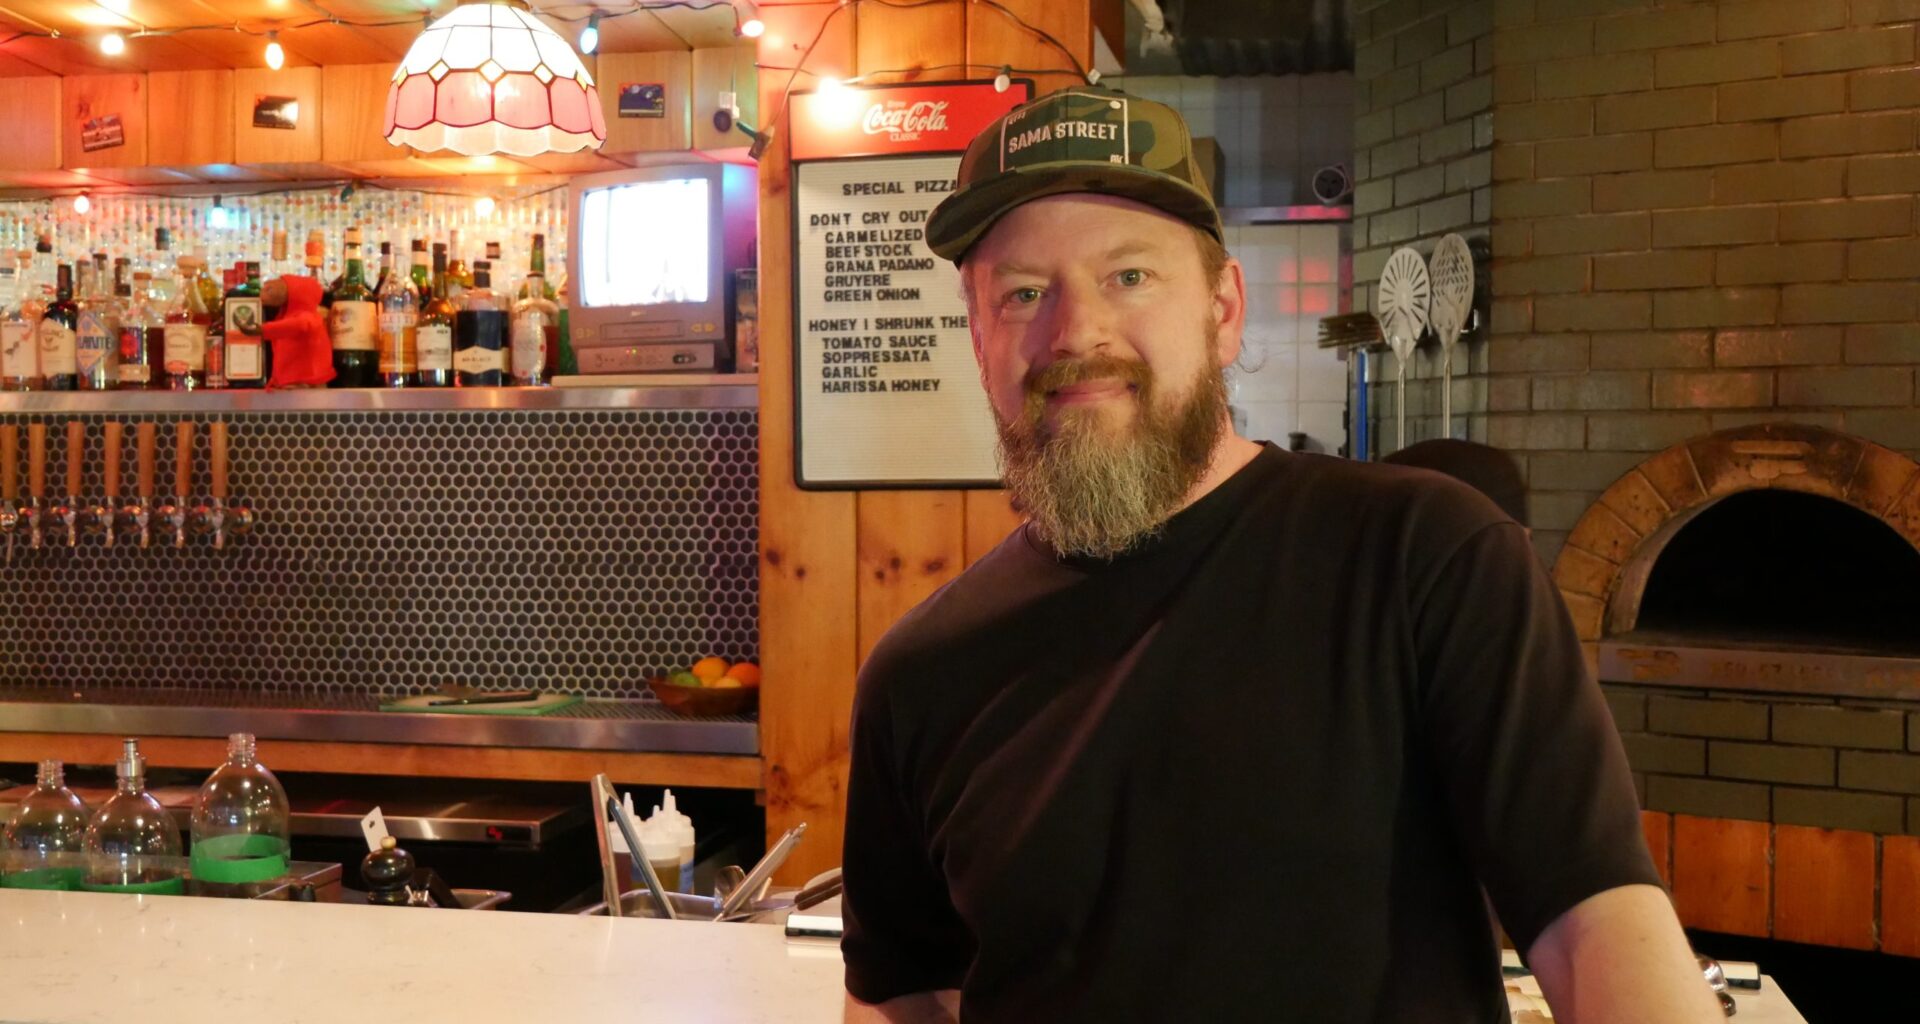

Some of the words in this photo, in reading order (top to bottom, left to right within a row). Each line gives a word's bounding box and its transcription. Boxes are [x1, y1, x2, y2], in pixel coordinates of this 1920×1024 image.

[1008, 125, 1052, 153] SAMA
[1055, 121, 1118, 140] STREET
[842, 182, 904, 196] SPECIAL
[810, 213, 851, 226] DONT
[862, 211, 890, 224] CRY
[899, 210, 928, 223] OUT
[825, 229, 923, 244] CARMELIZED
[826, 246, 861, 259] BEEF
[865, 244, 913, 257] STOCK
[825, 260, 875, 273] GRANA
[879, 258, 934, 271] PADANO
[825, 274, 891, 287] GRUYERE
[824, 289, 872, 302] GREEN
[876, 288, 920, 301] ONION
[808, 319, 857, 332] HONEY
[864, 318, 868, 330] I
[875, 317, 934, 330] SHRUNK
[940, 316, 968, 329] THE
[822, 336, 882, 349] TOMATO
[889, 335, 937, 348] SAUCE
[822, 350, 930, 364] SOPPRESSATA
[822, 366, 878, 378] GARLIC
[822, 380, 887, 393] HARISSA
[891, 379, 940, 391] HONEY
